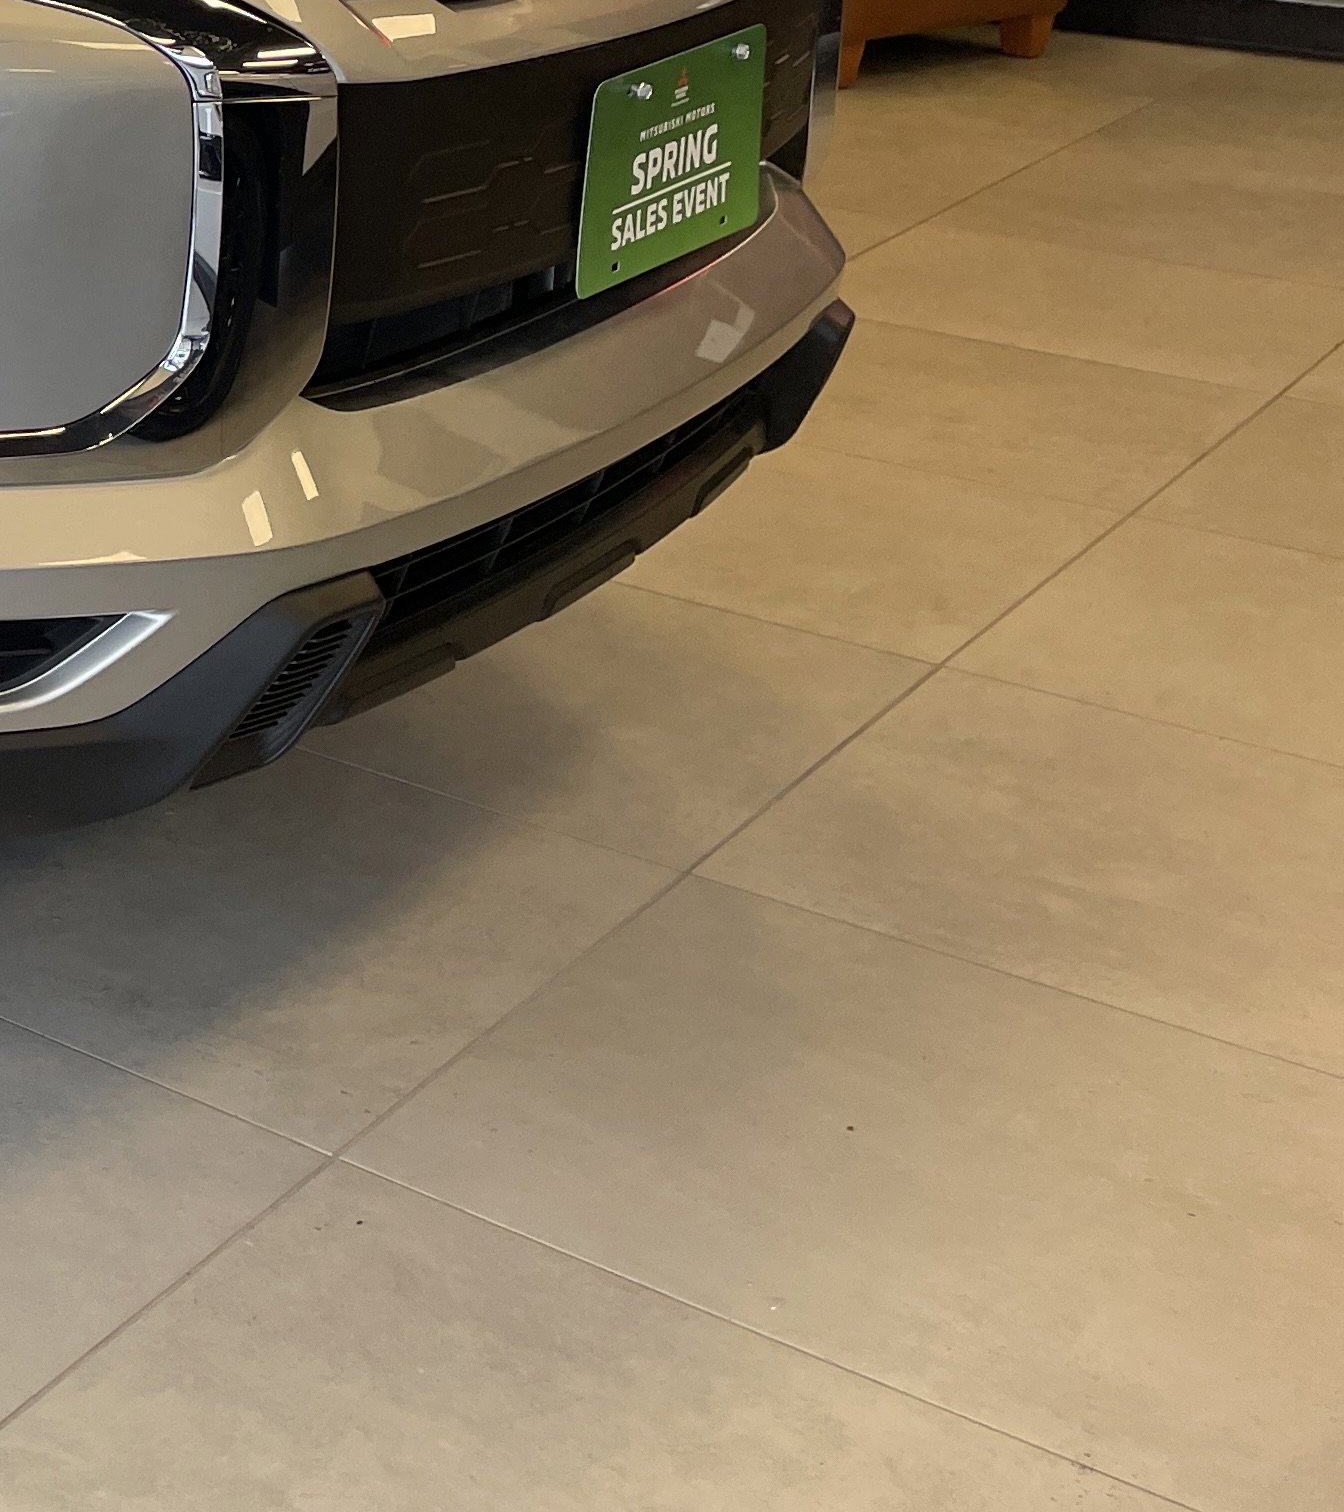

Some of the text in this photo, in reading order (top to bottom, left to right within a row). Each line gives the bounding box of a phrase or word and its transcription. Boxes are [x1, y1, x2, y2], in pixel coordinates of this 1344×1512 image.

[638, 102, 716, 143] MITSUBISHI MOTORS
[630, 123, 719, 196] SPRING
[610, 171, 731, 252] SALES EVENT
